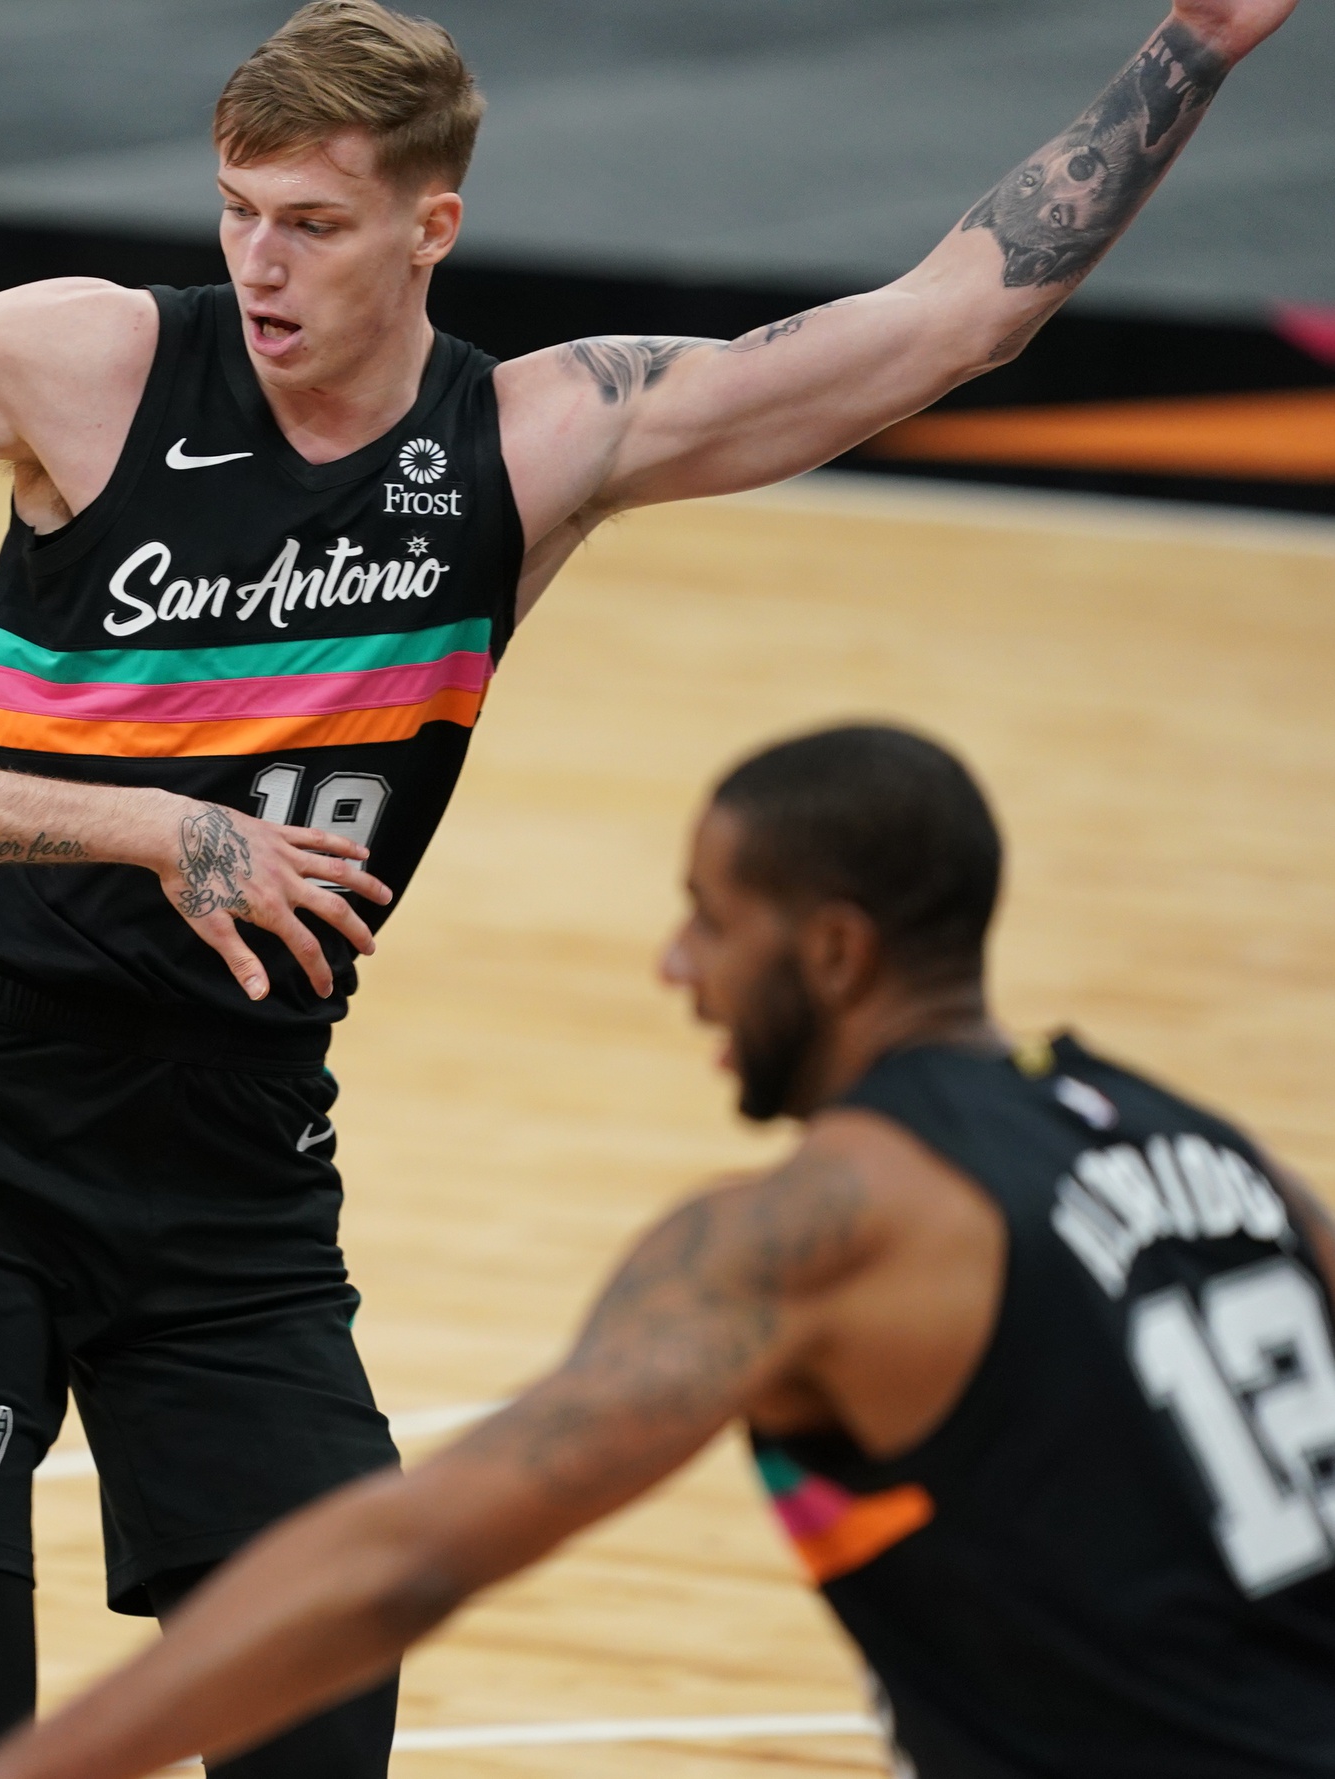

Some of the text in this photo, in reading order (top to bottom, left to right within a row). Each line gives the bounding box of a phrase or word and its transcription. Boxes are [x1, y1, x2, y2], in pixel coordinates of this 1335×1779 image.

[383, 483, 462, 516] Frost
[103, 536, 450, 637] San Antonio
